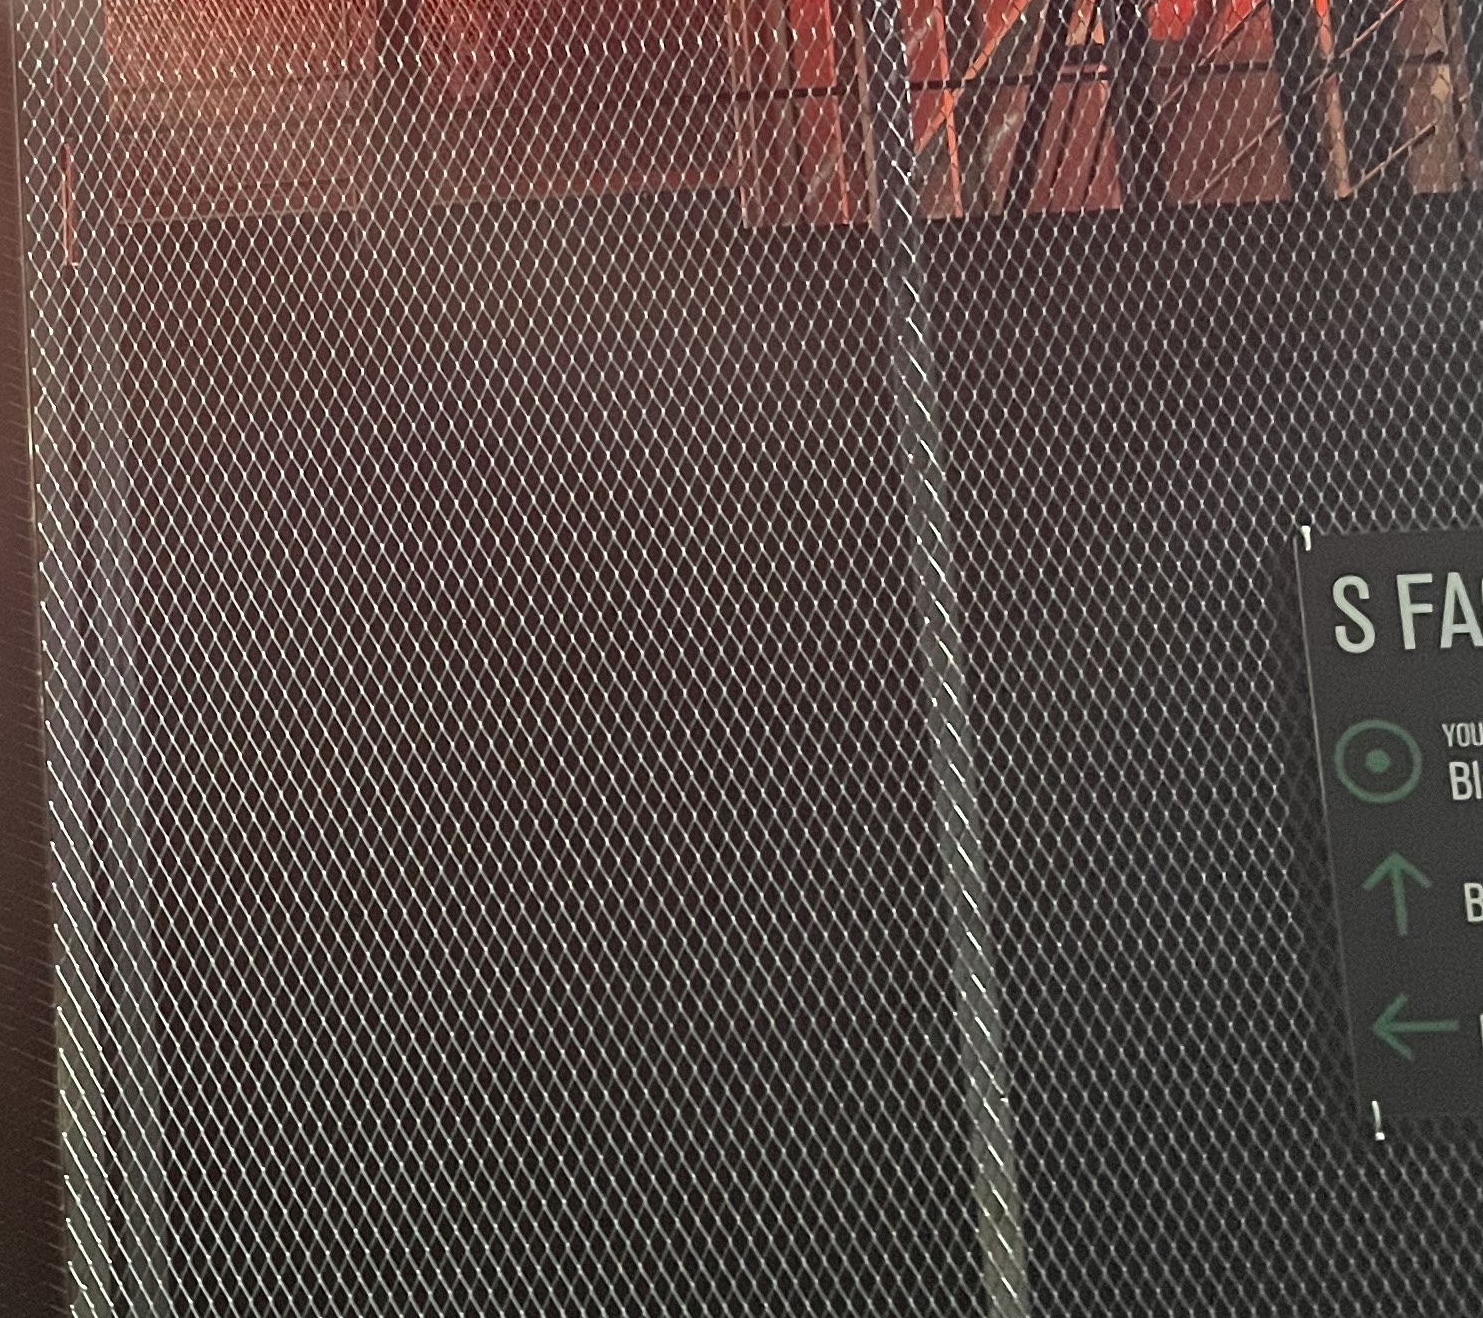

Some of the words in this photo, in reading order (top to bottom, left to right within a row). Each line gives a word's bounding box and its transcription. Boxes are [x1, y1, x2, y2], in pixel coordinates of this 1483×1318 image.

[1332, 574, 1376, 654] S
[1396, 571, 1483, 650] FA
[1441, 722, 1483, 748] YOU
[1449, 760, 1483, 800] BI
